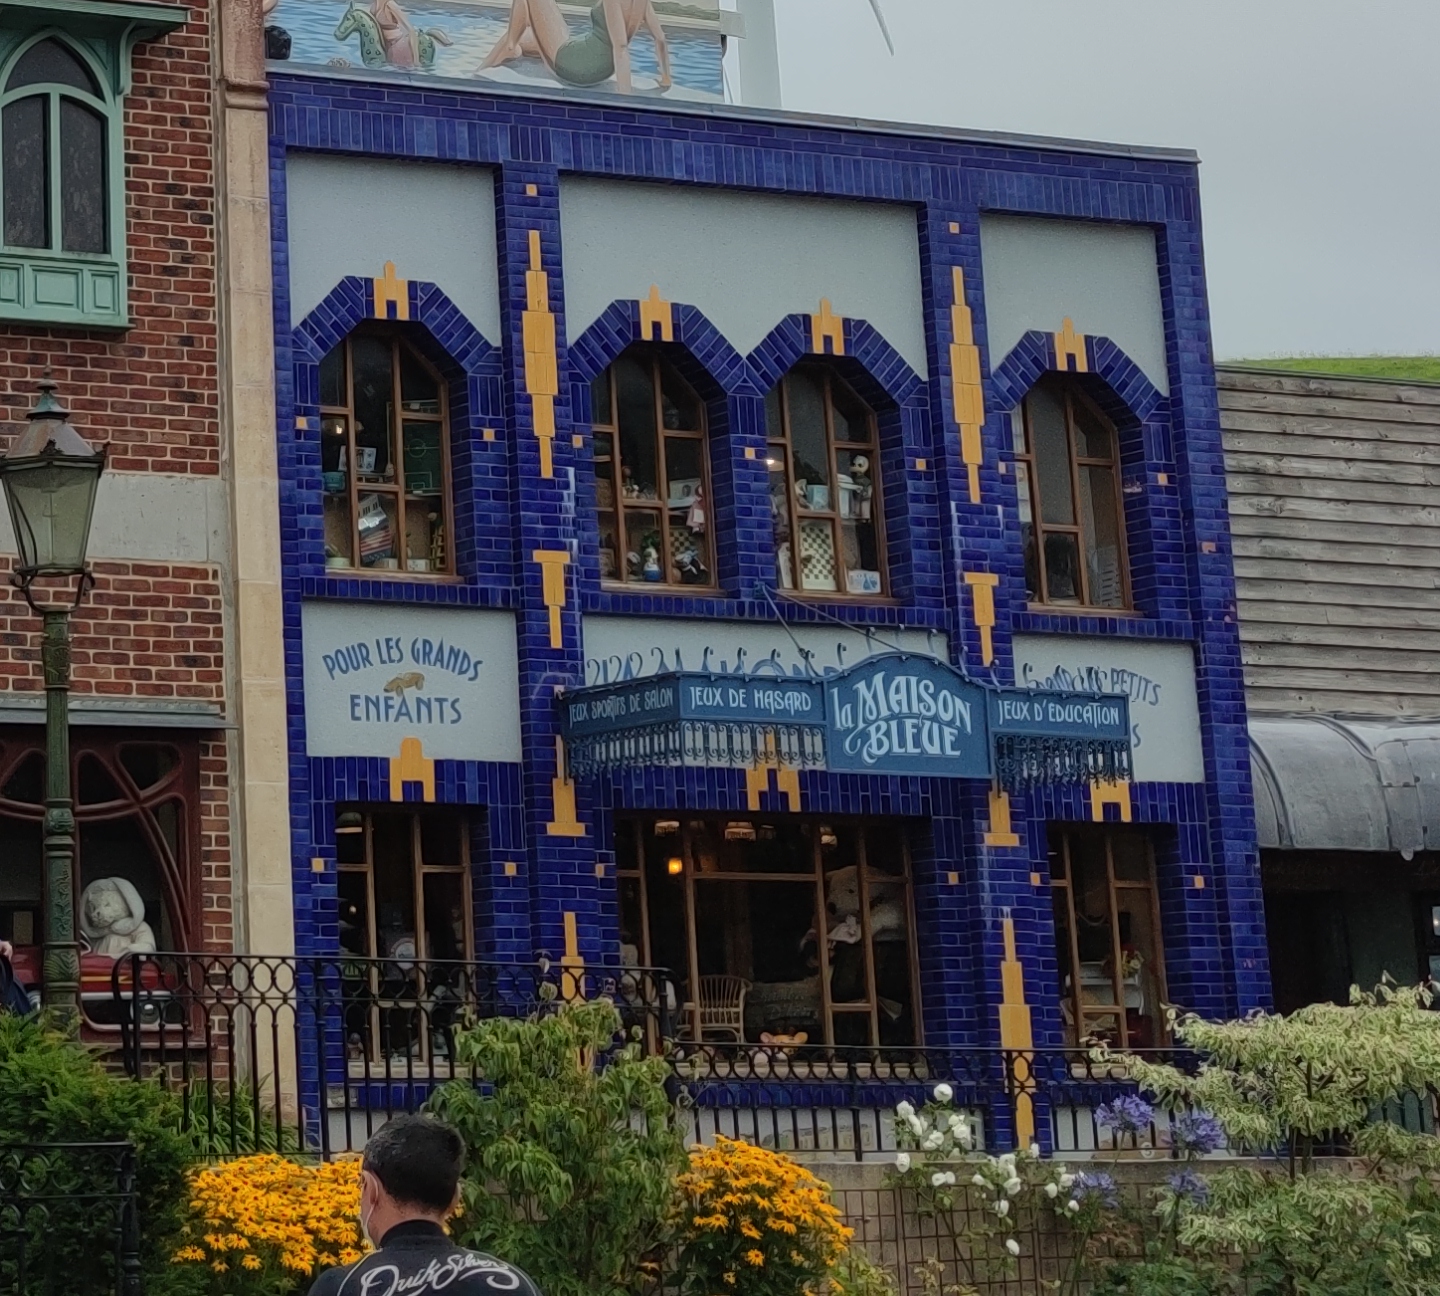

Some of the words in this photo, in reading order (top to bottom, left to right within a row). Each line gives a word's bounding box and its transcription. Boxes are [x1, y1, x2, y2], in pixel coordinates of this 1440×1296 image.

[322, 642, 374, 680] POUR
[376, 637, 404, 665] LES
[411, 636, 483, 681] GRANDS
[350, 694, 462, 724] ENFANTS
[569, 702, 589, 729] JEUX
[591, 695, 626, 722] SPORTIFS
[630, 693, 641, 713] DE
[645, 685, 673, 711] SALON
[689, 687, 724, 709] JEUX
[729, 688, 747, 708] DE
[754, 686, 811, 715] HASARD
[830, 687, 853, 731] la
[848, 671, 971, 740] MAISON
[998, 700, 1031, 724] JEUX
[862, 718, 961, 764] BLEUE
